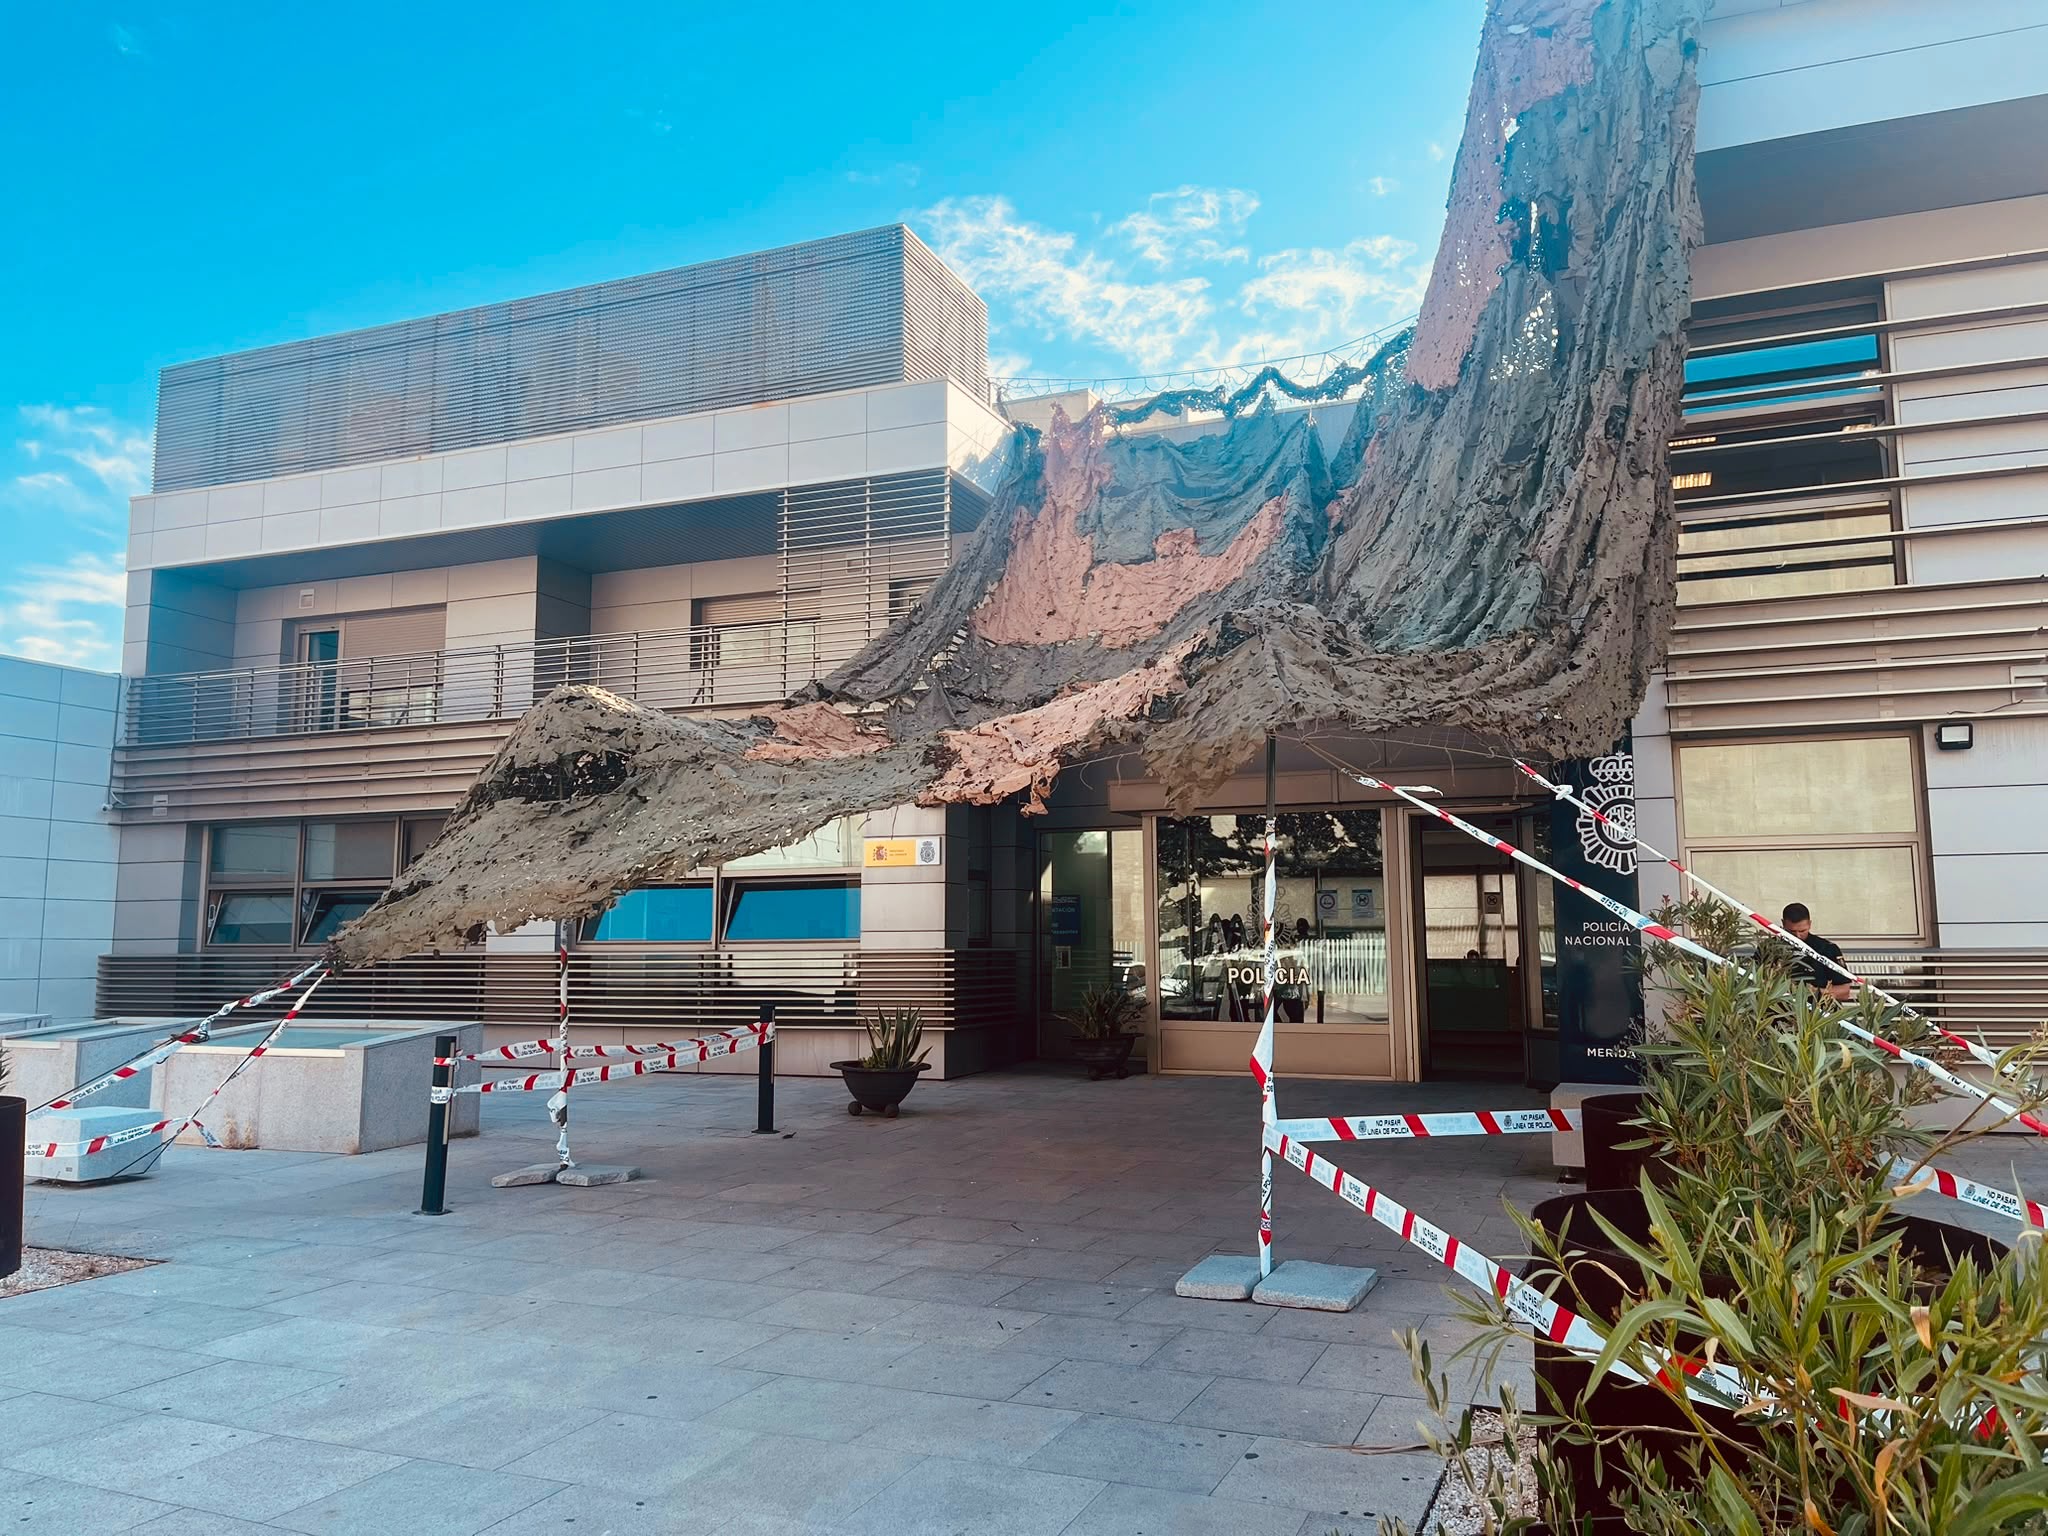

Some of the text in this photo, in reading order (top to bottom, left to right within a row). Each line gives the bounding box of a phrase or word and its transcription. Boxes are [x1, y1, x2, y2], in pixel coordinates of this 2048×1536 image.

[1583, 920, 1631, 932] POLICÍA
[1564, 936, 1631, 946] NACIONAL
[1228, 967, 1311, 985] POLCIA
[1384, 1119, 1401, 1127] PASAR
[1987, 1190, 2017, 1206] NO PASAR
[1990, 1201, 2001, 1209] DE
